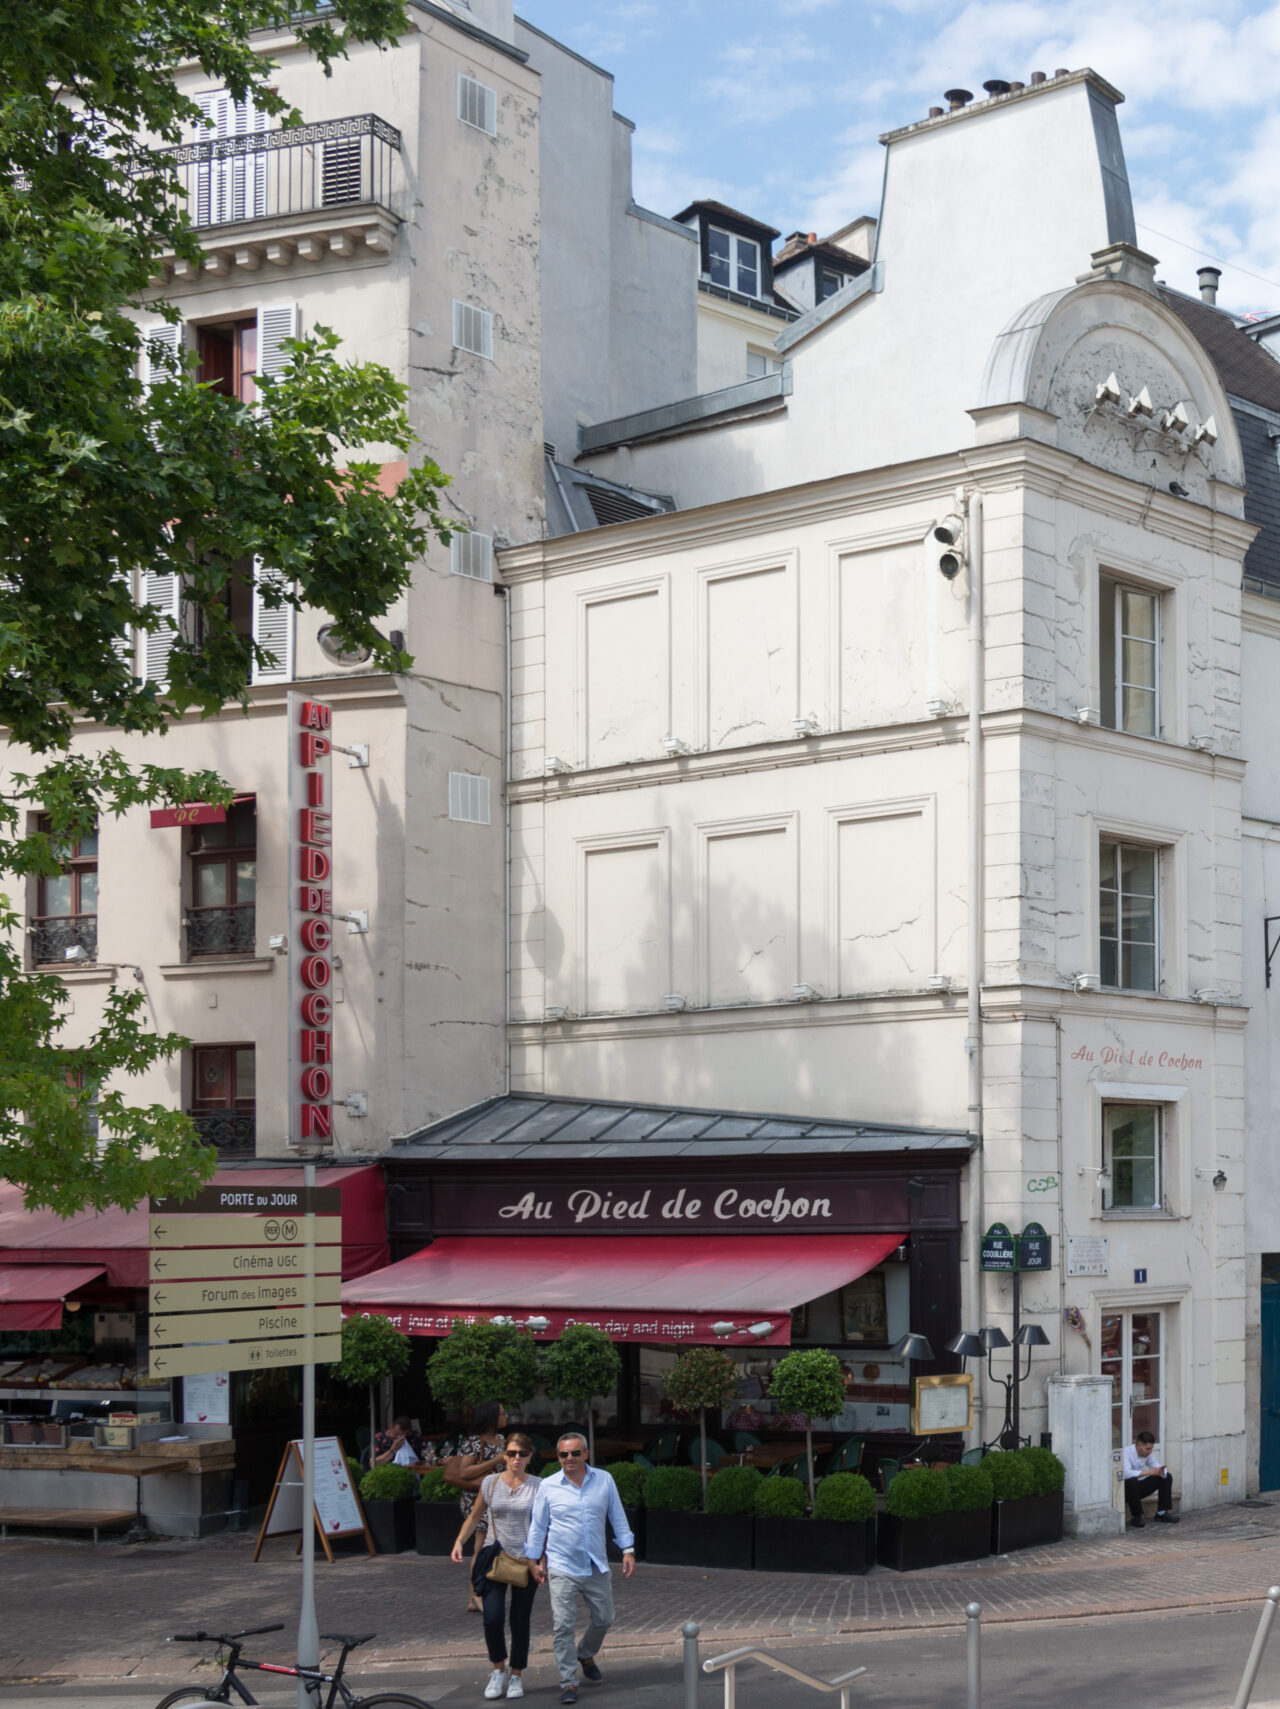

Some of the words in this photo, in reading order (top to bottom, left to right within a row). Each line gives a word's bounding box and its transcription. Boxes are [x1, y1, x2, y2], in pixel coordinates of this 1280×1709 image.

[301, 702, 331, 730] AU
[301, 732, 331, 883] PIED
[301, 886, 331, 914] DE
[301, 918, 332, 1138] COCHON
[1070, 1045, 1095, 1061] Au
[1139, 1050, 1154, 1066] de
[220, 1193, 254, 1206] PORTE
[257, 1196, 268, 1206] DU
[270, 1194, 298, 1206] JOUR
[498, 1192, 553, 1220] Au
[567, 1189, 651, 1223] Pied
[661, 1188, 702, 1219] de
[714, 1188, 833, 1222] Cochon
[993, 1241, 1003, 1249] RUE
[1028, 1242, 1040, 1250] RUE
[233, 1255, 273, 1269] Cinéma
[277, 1255, 297, 1267] UGC
[1027, 1257, 1042, 1266] JOUR
[202, 1290, 239, 1302] Forum
[241, 1291, 256, 1300] des
[258, 1286, 298, 1301] images
[259, 1316, 297, 1329] Piscine
[408, 1314, 433, 1332] jour
[436, 1315, 449, 1328] et
[604, 1320, 630, 1338] day
[632, 1320, 658, 1334] and
[661, 1321, 695, 1339] night
[265, 1348, 297, 1359] Toilettes
